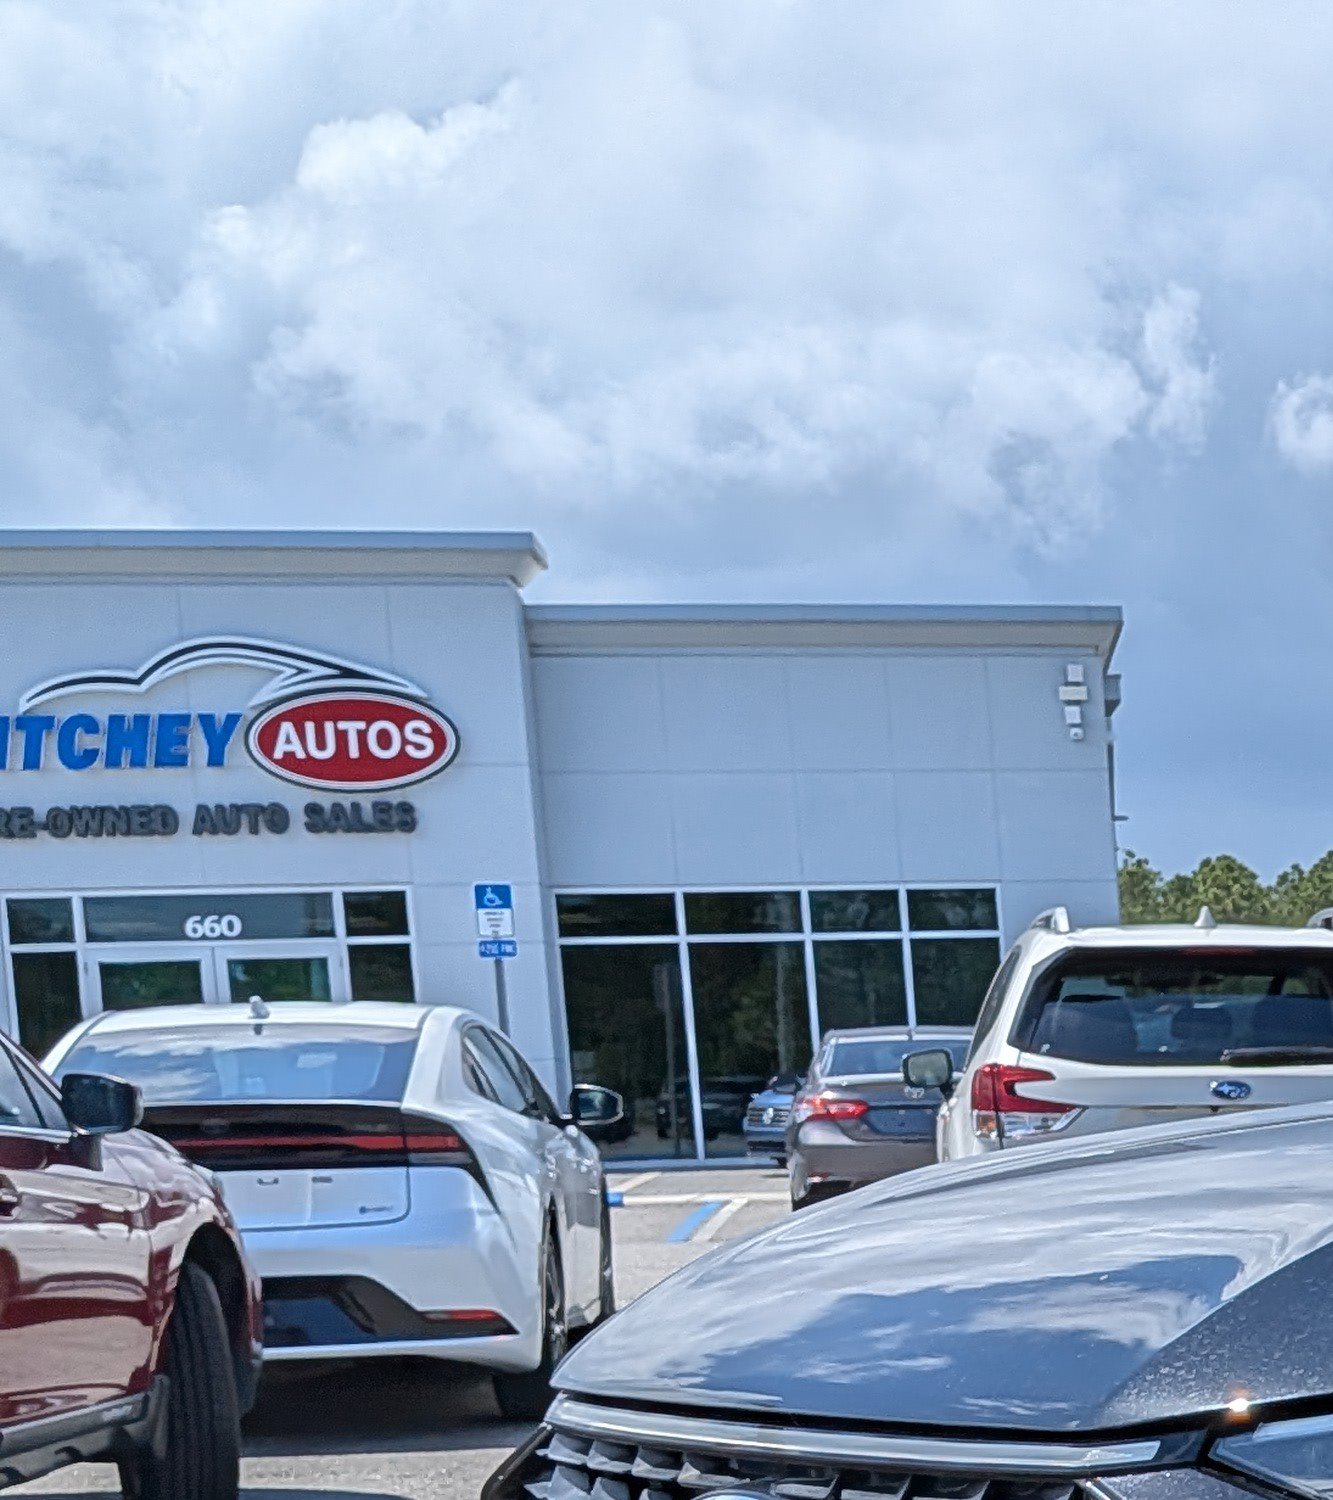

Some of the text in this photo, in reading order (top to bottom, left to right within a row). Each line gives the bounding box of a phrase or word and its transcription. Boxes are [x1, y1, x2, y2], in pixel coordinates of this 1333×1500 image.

[273, 720, 435, 760] AUTOS
[192, 802, 290, 836] AUTO
[304, 801, 418, 834] SALES
[185, 914, 242, 938] 660
